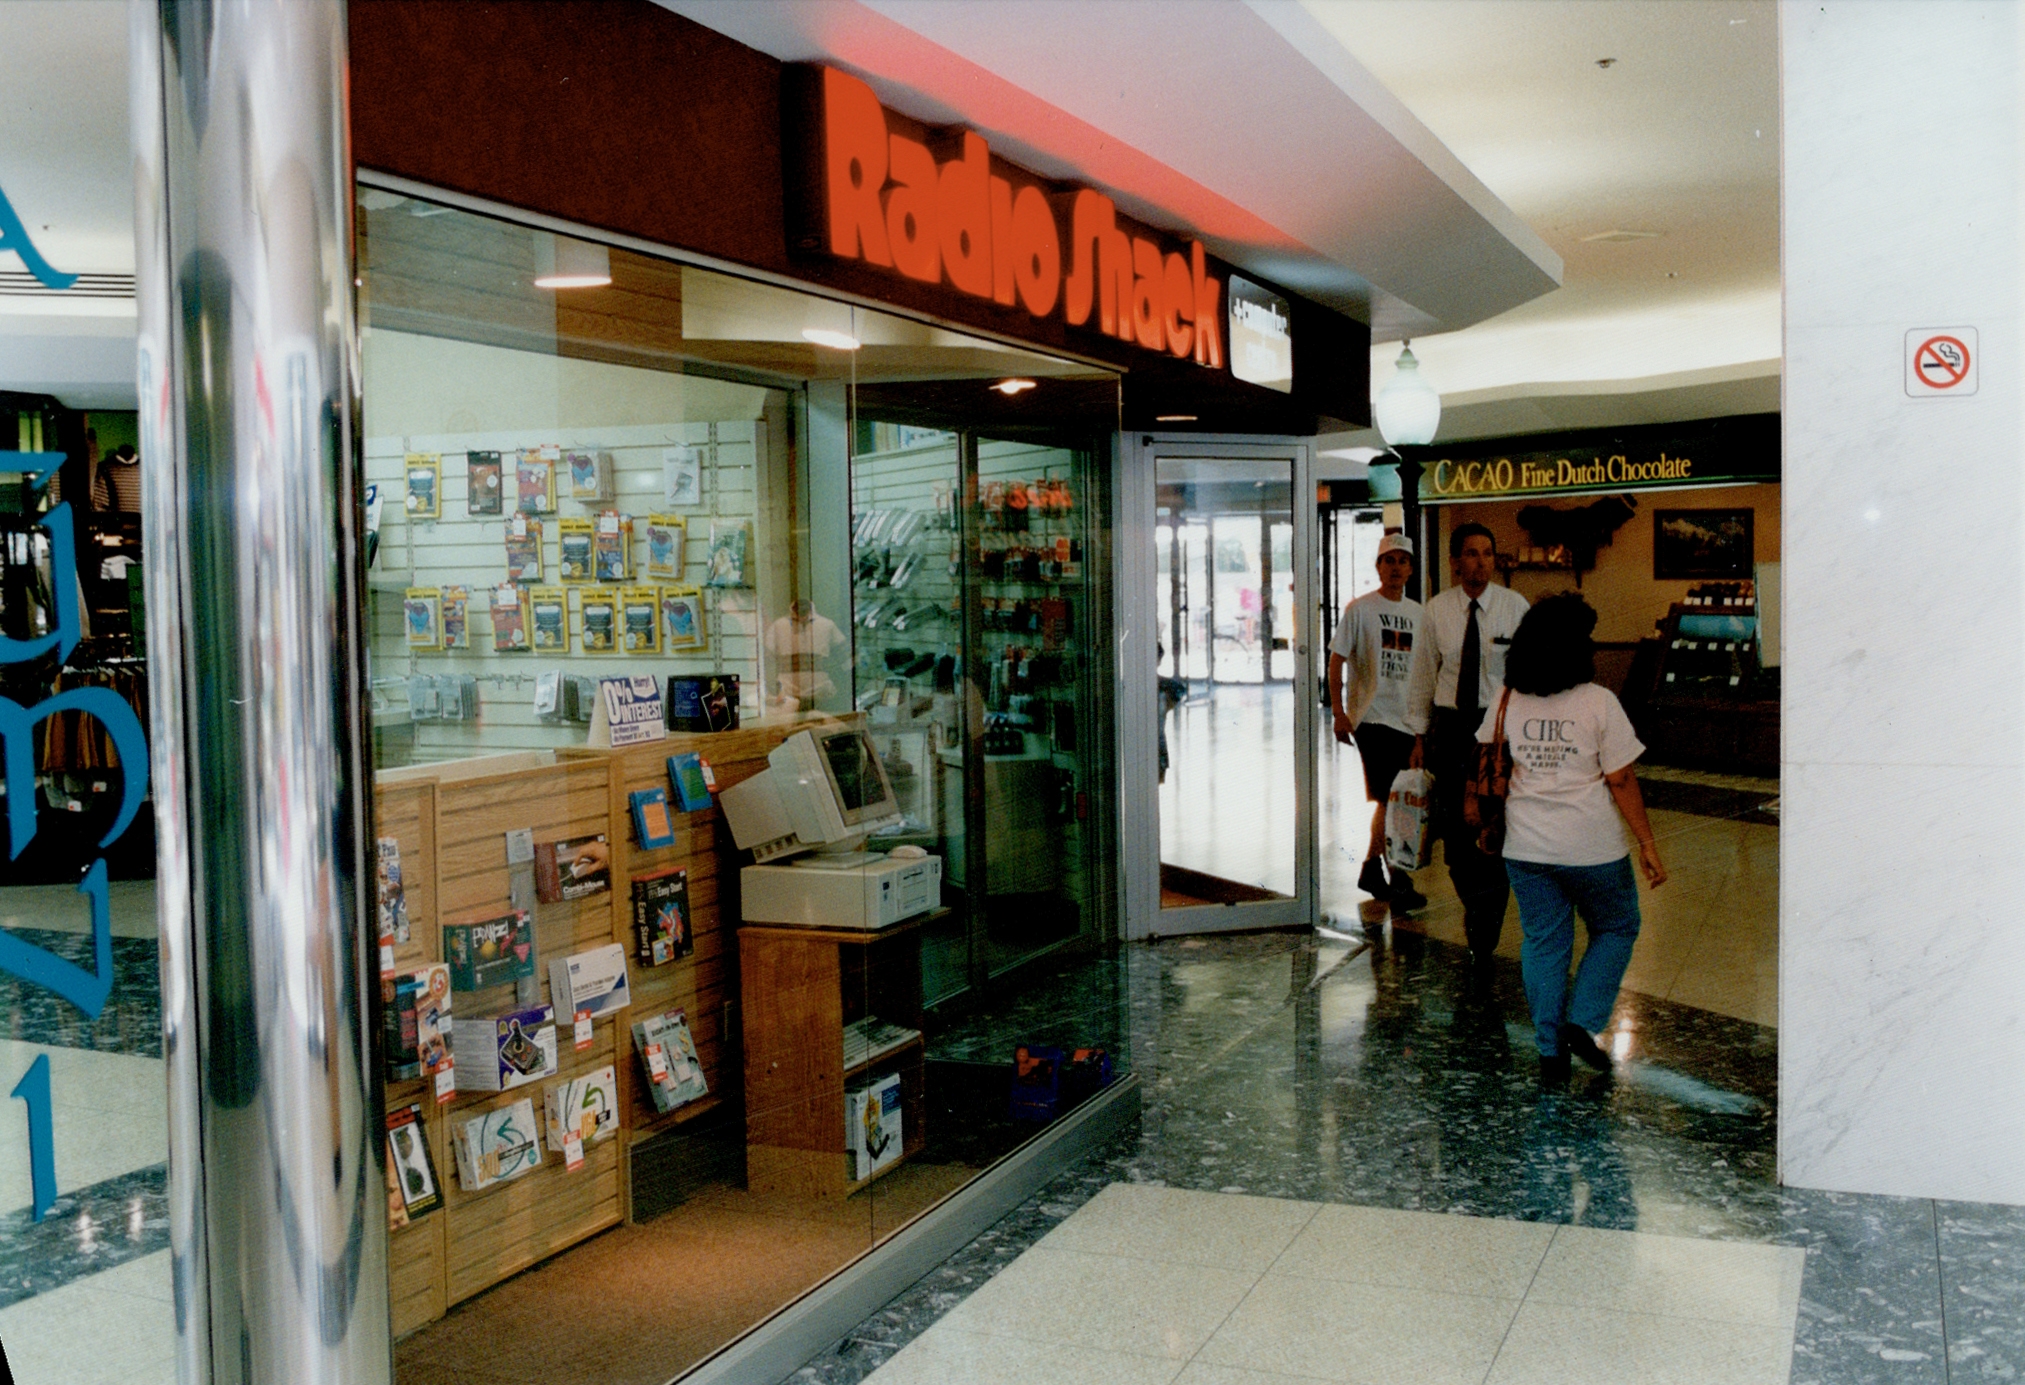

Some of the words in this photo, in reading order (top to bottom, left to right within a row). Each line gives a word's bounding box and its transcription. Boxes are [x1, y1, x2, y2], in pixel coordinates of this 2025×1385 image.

[824, 66, 1060, 317] Radio
[1066, 188, 1222, 369] Shack
[1434, 458, 1513, 494] CACAO
[1521, 461, 1555, 488] Fine
[1556, 457, 1606, 486] Dutch
[1607, 453, 1692, 483] Chocolate
[1379, 613, 1413, 630] WHO
[620, 699, 662, 723] INTEREST
[1523, 718, 1575, 743] CIBC
